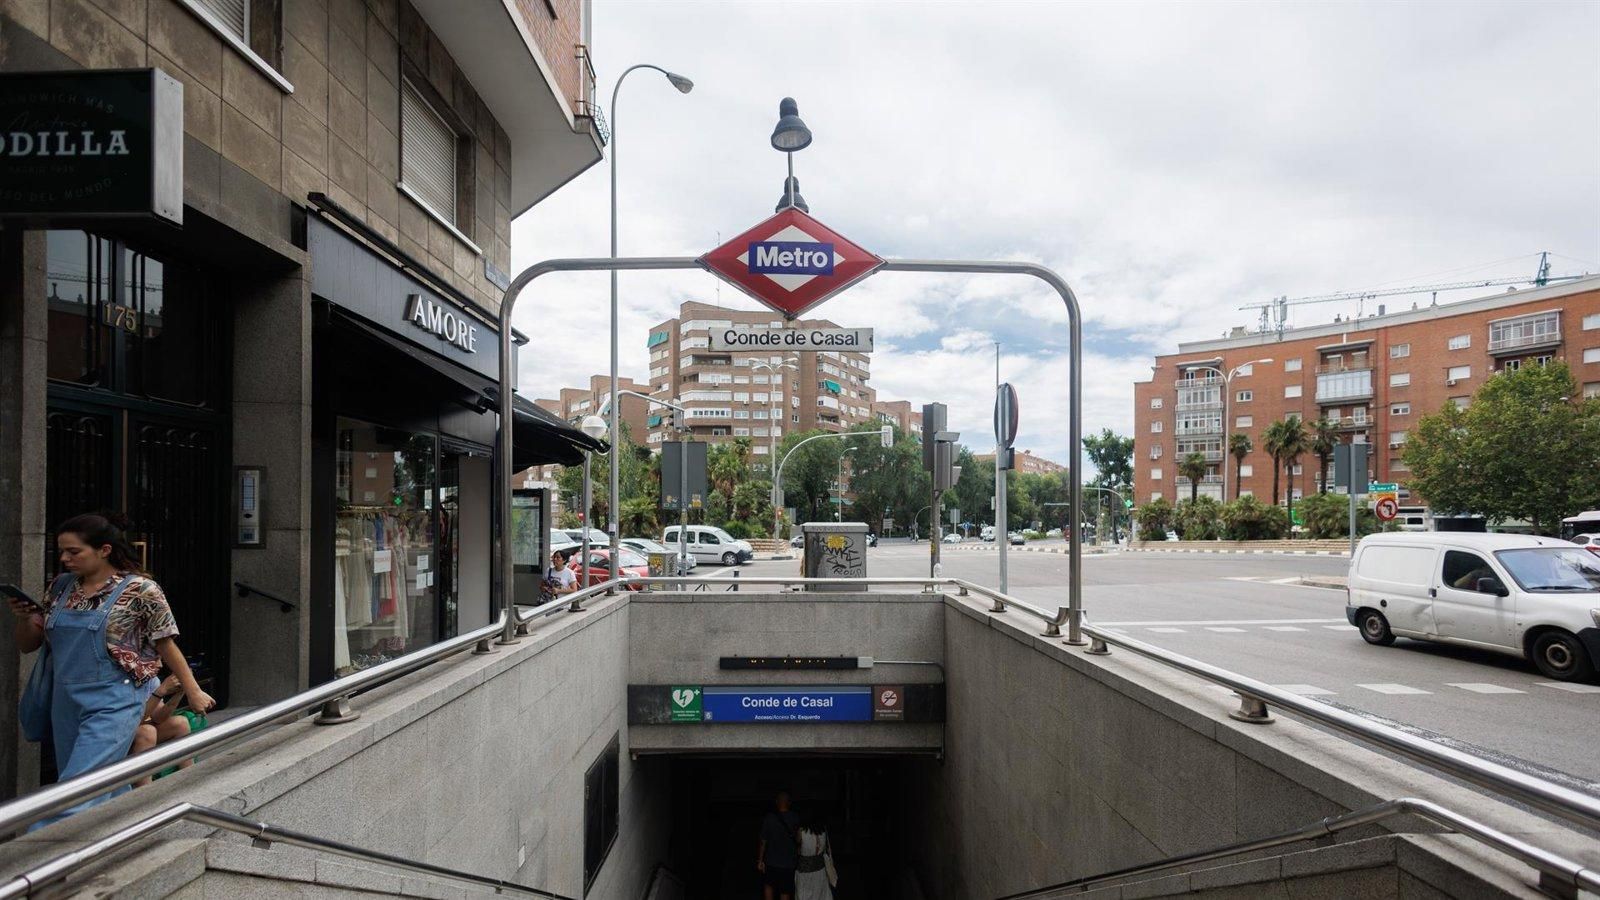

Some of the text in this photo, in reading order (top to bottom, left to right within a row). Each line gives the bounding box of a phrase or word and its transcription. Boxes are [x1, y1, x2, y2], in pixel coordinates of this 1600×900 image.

[0, 130, 130, 156] DILLA
[756, 246, 828, 268] Metro
[106, 302, 136, 331] 175
[412, 294, 477, 353] AMORE
[724, 329, 859, 346] Conde de Casal
[742, 697, 833, 707] Conde de Casal
